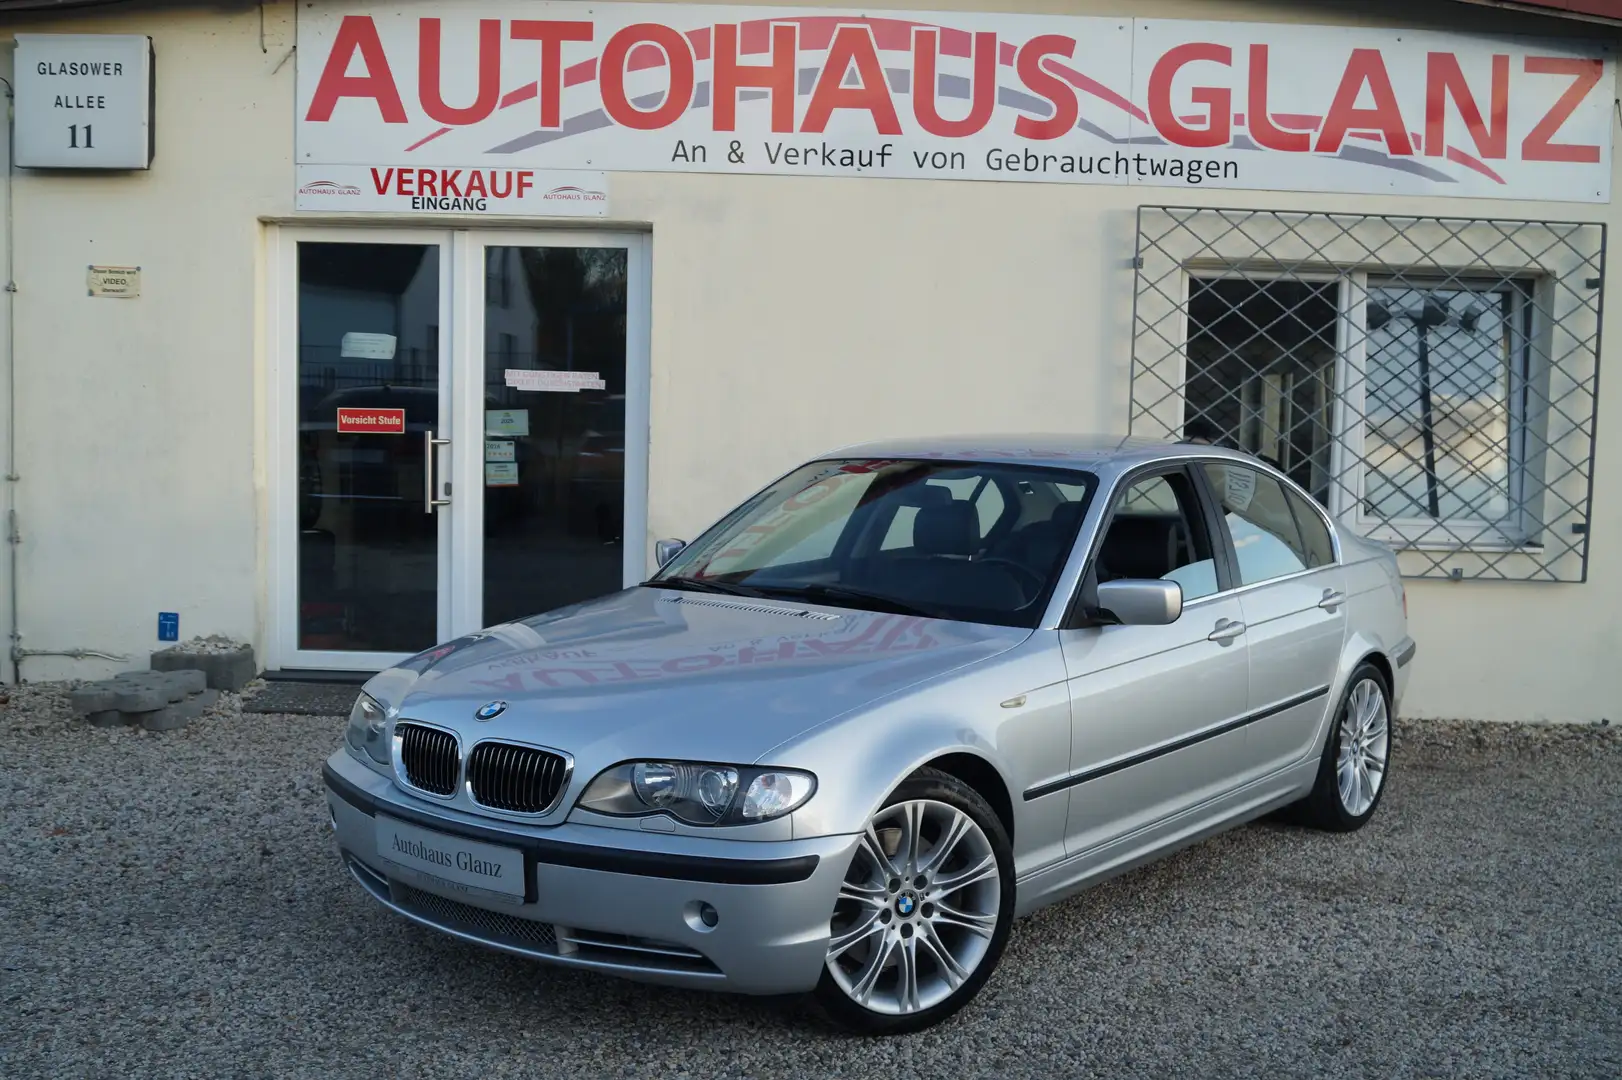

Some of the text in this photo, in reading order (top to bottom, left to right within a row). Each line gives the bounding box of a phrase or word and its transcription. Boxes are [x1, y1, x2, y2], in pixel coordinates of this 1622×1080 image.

[37, 62, 123, 76] GLASOWER
[54, 95, 106, 109] ALLEE
[305, 15, 1604, 164] AUTOHAUS GLANZ
[67, 123, 95, 149] 11
[671, 139, 1239, 184] An & Verkauf von Gebrauchtwagen
[369, 167, 534, 199] VERKAUF
[411, 196, 487, 212] EINGANG
[340, 414, 401, 425] Vorsicht Stufe
[392, 833, 502, 879] Autohaus Glanz
